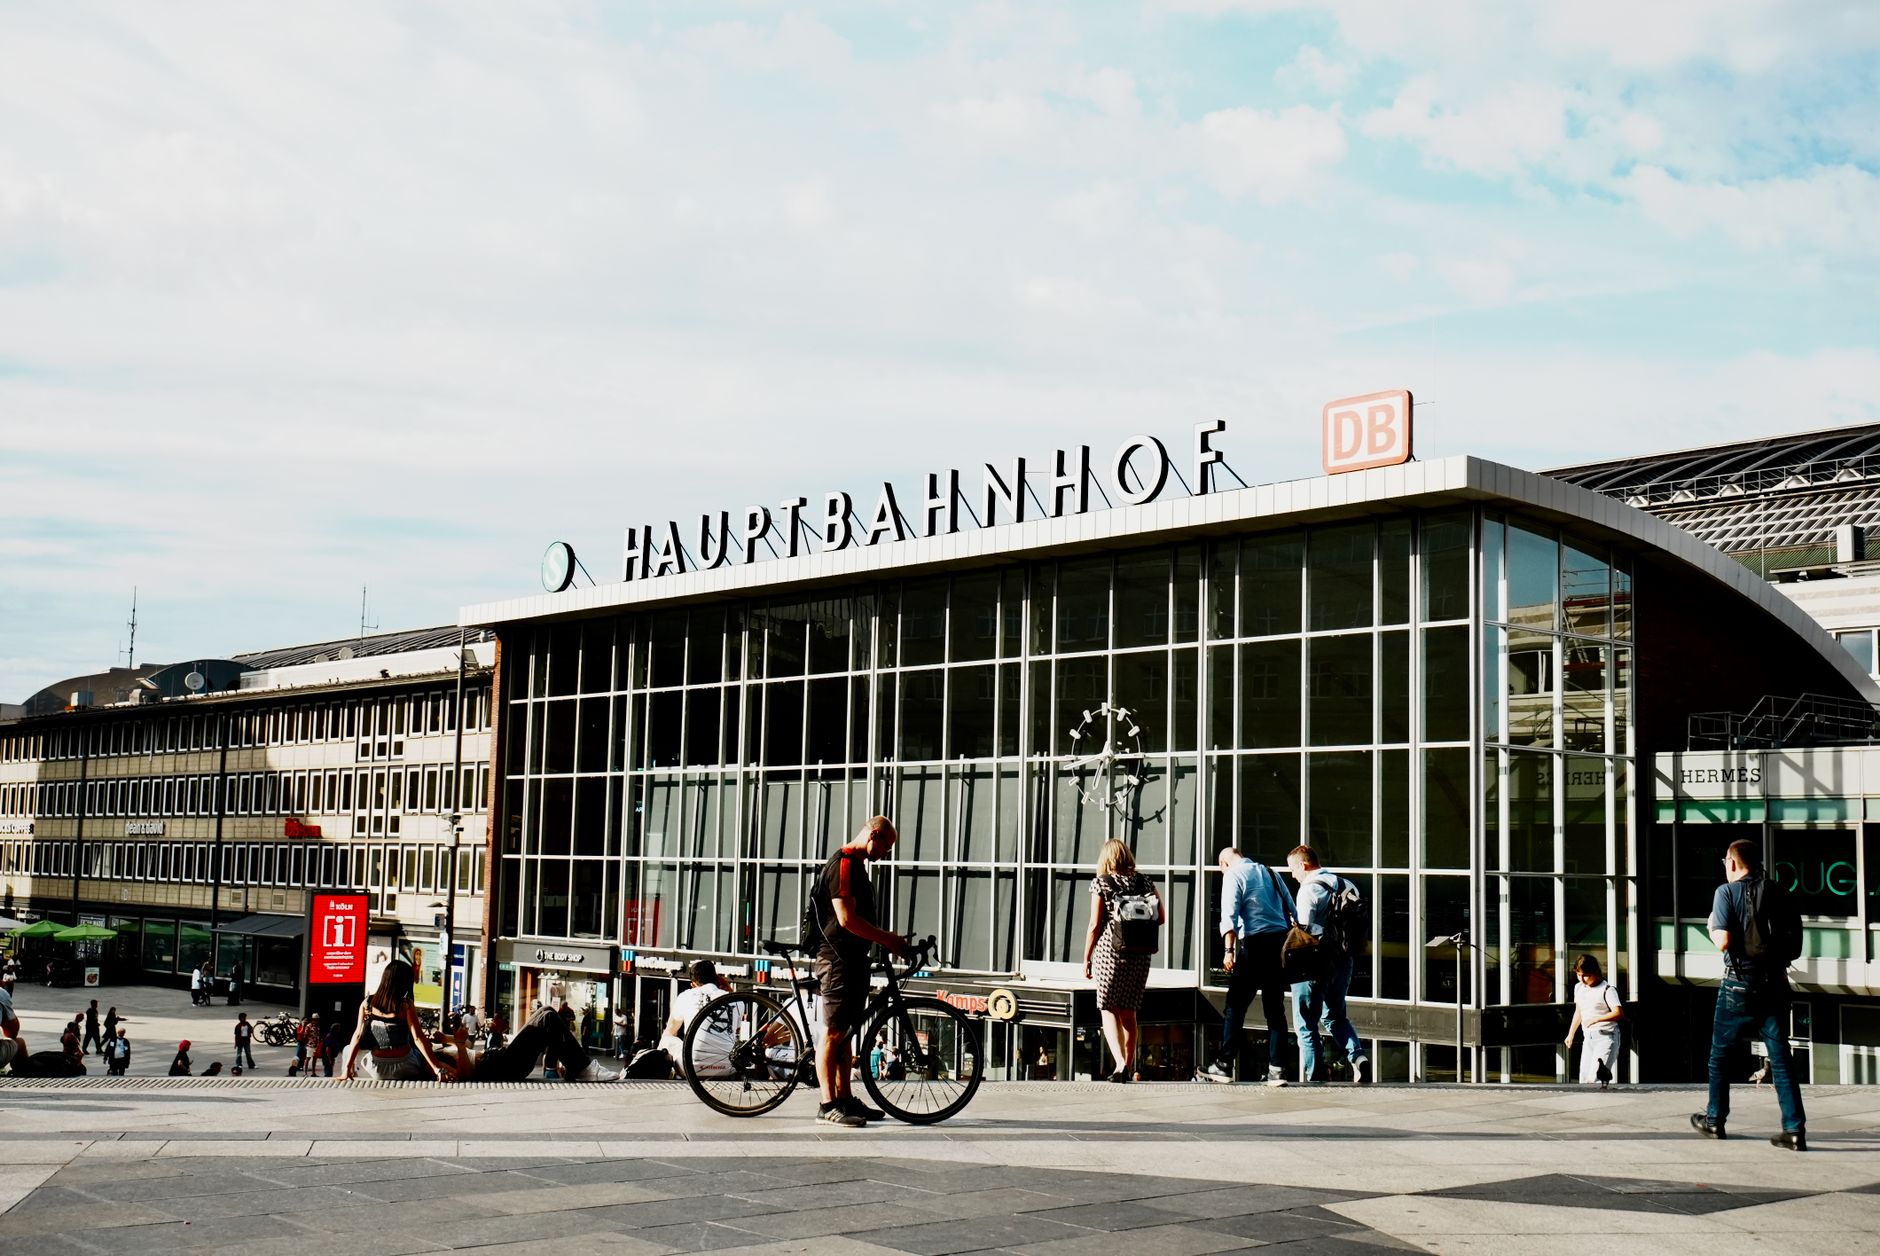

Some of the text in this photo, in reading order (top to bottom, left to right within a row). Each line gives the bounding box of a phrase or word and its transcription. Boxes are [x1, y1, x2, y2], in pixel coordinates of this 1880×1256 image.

[1333, 403, 1397, 461] DB
[622, 419, 1226, 583] HAUPTBAHNHOF
[335, 902, 354, 910] KÖLN
[544, 951, 582, 962] THE BODY SHOP
[936, 989, 989, 1015] Kamps
